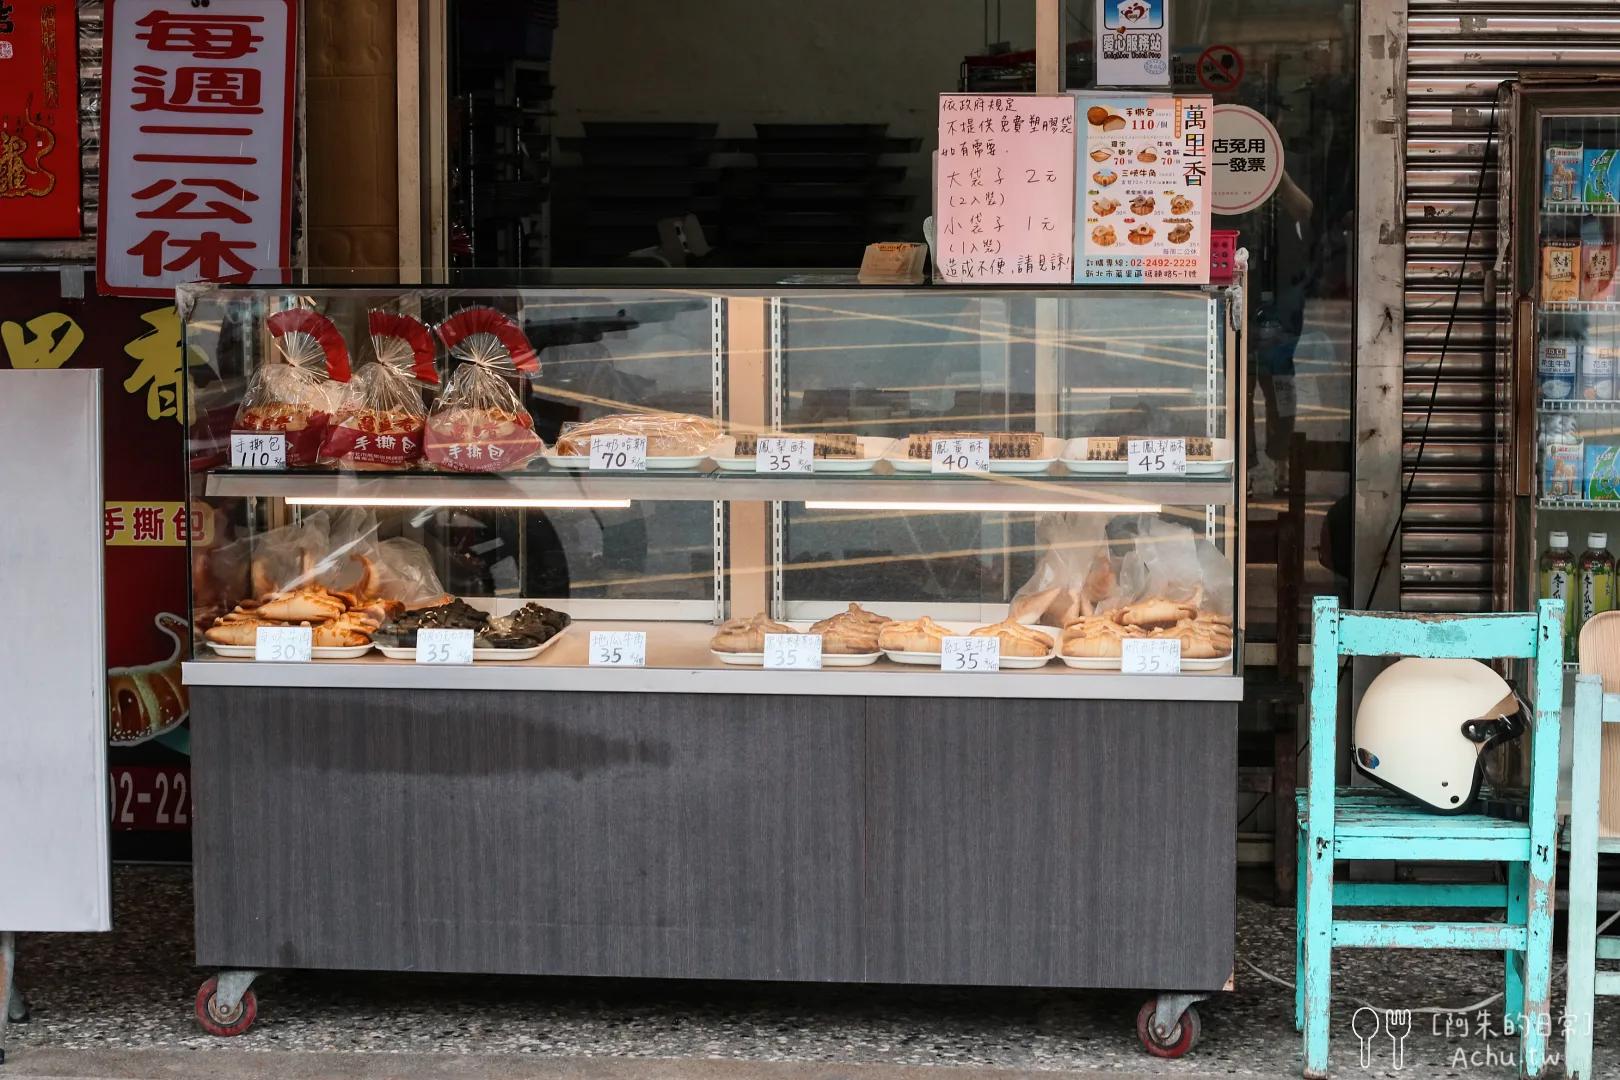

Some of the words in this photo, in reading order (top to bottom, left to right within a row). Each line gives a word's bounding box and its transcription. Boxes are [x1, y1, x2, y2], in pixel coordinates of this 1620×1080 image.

[1103, 33, 1161, 52] 愛心服務站
[942, 98, 1017, 112] 依政府規定
[1126, 108, 1154, 117] 手撕包
[947, 115, 1073, 135] 不提供免費塑膠袋
[127, 10, 264, 284] 每週二公休
[1183, 105, 1207, 186] 萬里香
[947, 167, 1004, 188] 大袋子
[1025, 169, 1057, 184] 2元
[1122, 169, 1156, 178] 三峽牛角
[944, 212, 1004, 234] 小袋子
[236, 436, 280, 453] 手撕包
[354, 435, 417, 453] 手撕包
[449, 443, 504, 460] 手撕包
[591, 437, 646, 453] 牛奶哈斯
[759, 439, 806, 455] 鳳梨酥
[1130, 440, 1184, 454] 土鳳梨酥
[241, 452, 269, 467] 110
[601, 453, 627, 469] 70
[769, 455, 791, 471] 35
[942, 454, 969, 472] 40
[1139, 455, 1165, 471] 45
[105, 507, 205, 541] 手撕包
[592, 632, 644, 648] 地瓜牛角
[944, 637, 997, 654] 紅豆牛角
[271, 644, 296, 660] 30
[427, 643, 450, 662] 35
[600, 648, 622, 663] 35
[775, 650, 797, 667] 35
[955, 652, 978, 670] 35
[1137, 655, 1160, 672] 35
